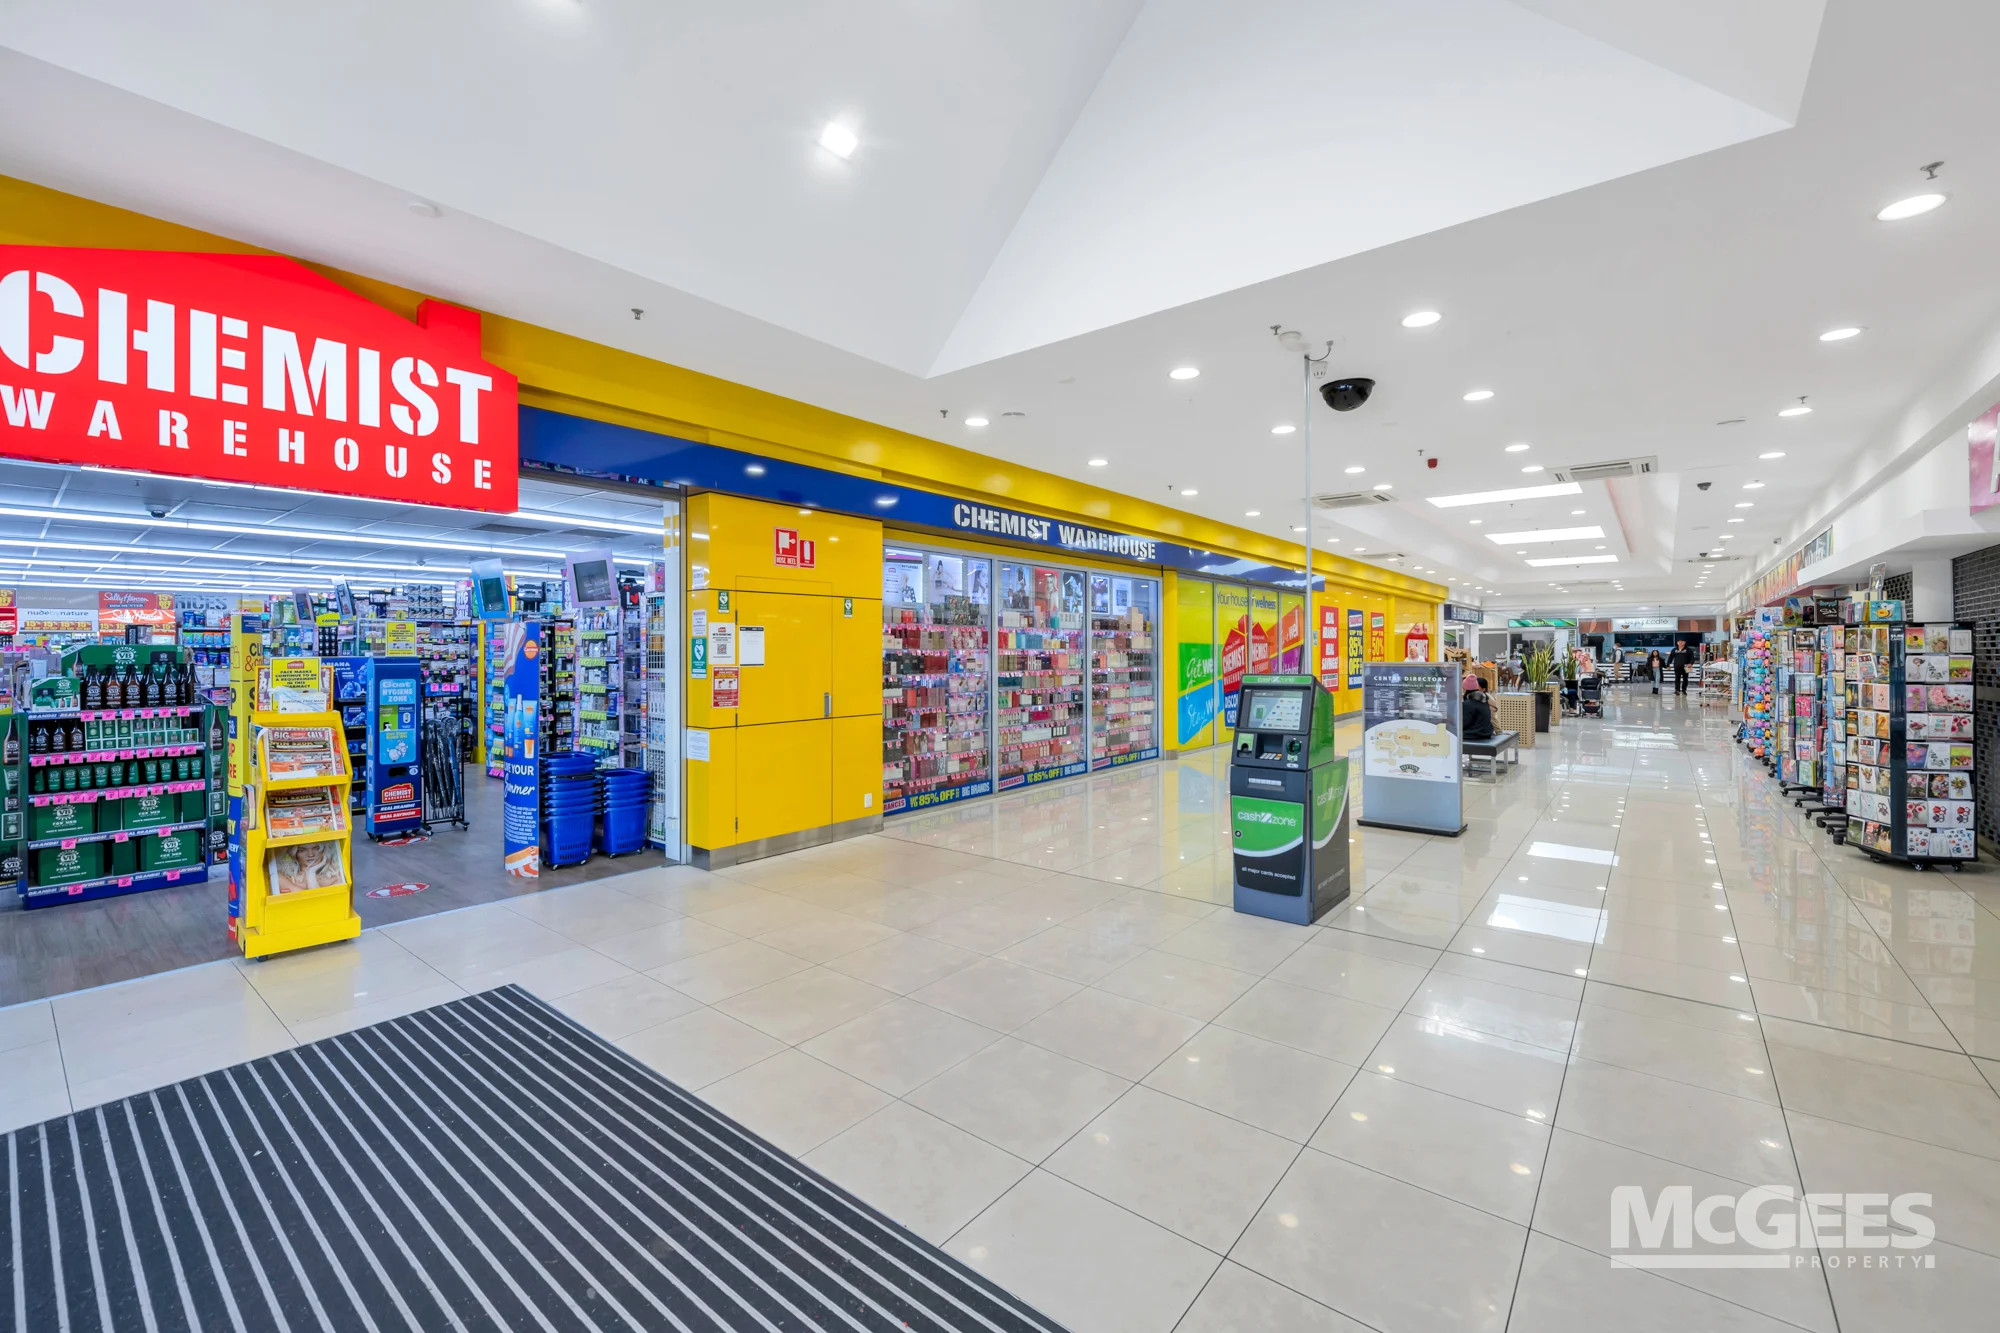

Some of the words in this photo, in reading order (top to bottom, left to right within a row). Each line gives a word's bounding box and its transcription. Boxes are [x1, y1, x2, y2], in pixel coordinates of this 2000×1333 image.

[0, 269, 493, 445] CHEMIST
[0, 384, 493, 490] WAREHOUSE
[953, 503, 1051, 541] CHEMIST
[1058, 524, 1156, 560] WAREHOUSE
[776, 556, 787, 564] HOSE
[787, 557, 796, 565] REEL
[1217, 592, 1229, 605] Your
[1230, 592, 1248, 607] house
[1255, 596, 1277, 610] wellness
[1349, 636, 1362, 657] 85%
[511, 764, 534, 776] YOUR
[1033, 771, 1048, 782] 85%
[1048, 768, 1060, 779] OFF
[384, 789, 411, 797] CHEMIST
[919, 793, 939, 806] 85%
[939, 788, 955, 801] OFF
[961, 786, 970, 797] BIG
[1237, 811, 1260, 822] cash
[1272, 816, 1296, 827] zone
[1274, 872, 1296, 880] accepted
